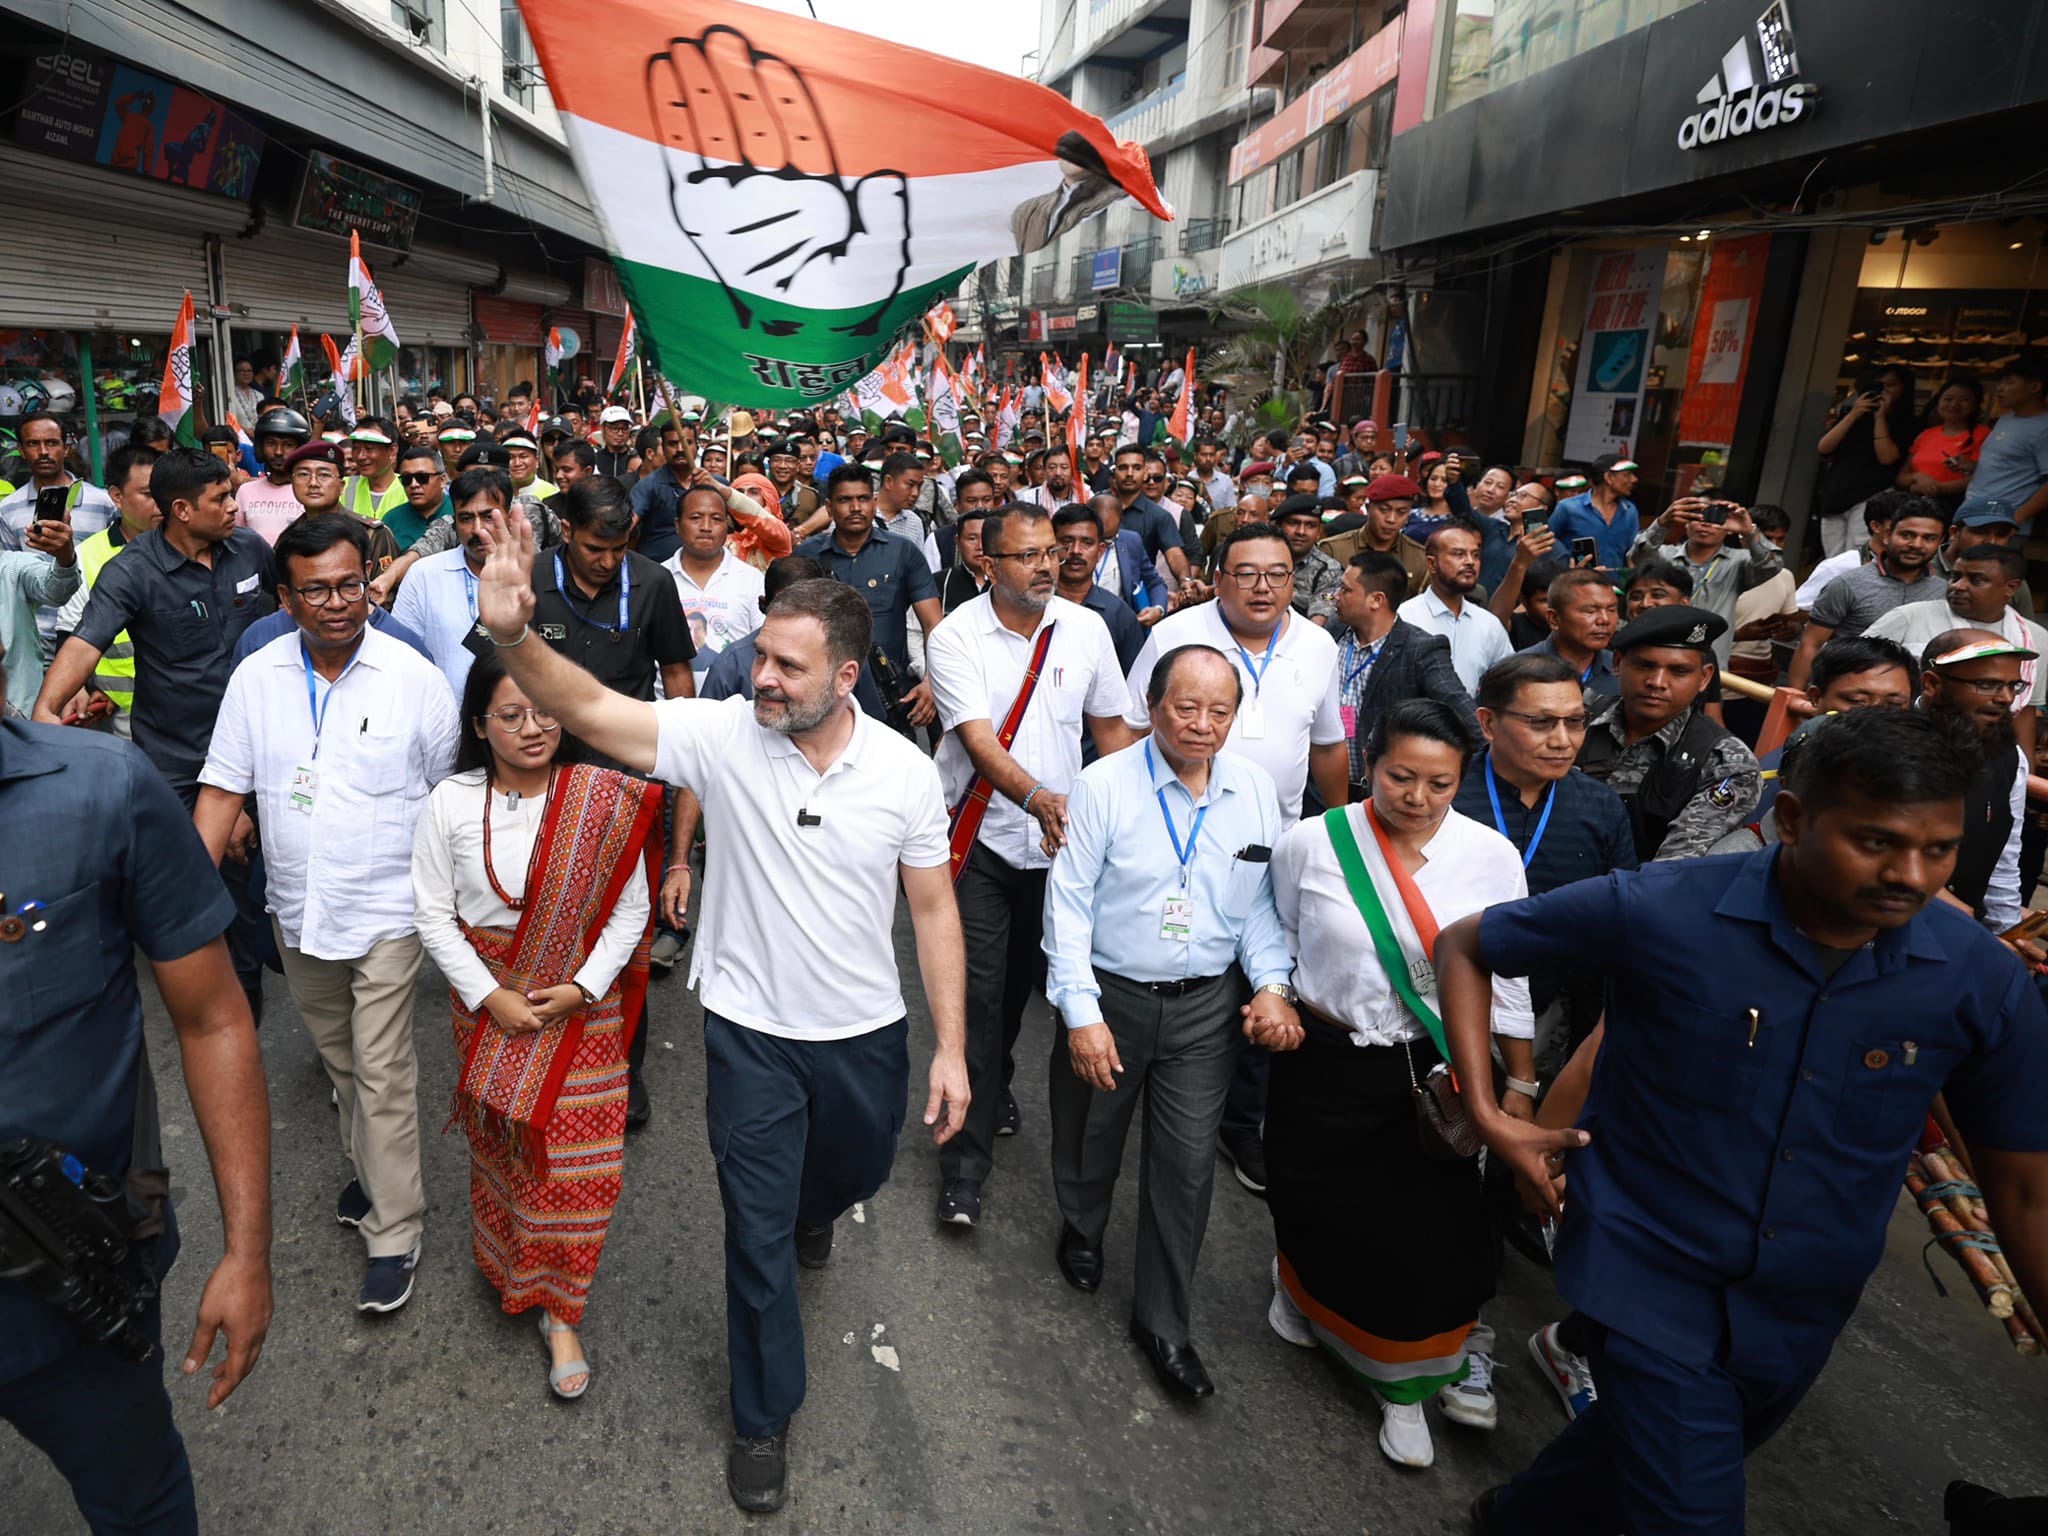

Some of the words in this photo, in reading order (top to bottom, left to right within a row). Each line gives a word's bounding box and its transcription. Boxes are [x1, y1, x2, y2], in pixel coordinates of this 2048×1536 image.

[54, 119, 72, 131] AUTO
[72, 124, 94, 137] WORKS
[1678, 83, 1805, 150] adidas
[328, 208, 343, 220] THE
[344, 212, 372, 228] HELMET
[372, 221, 392, 233] SHOP
[1711, 328, 1739, 354] 50%
[742, 352, 871, 398] राहुल
